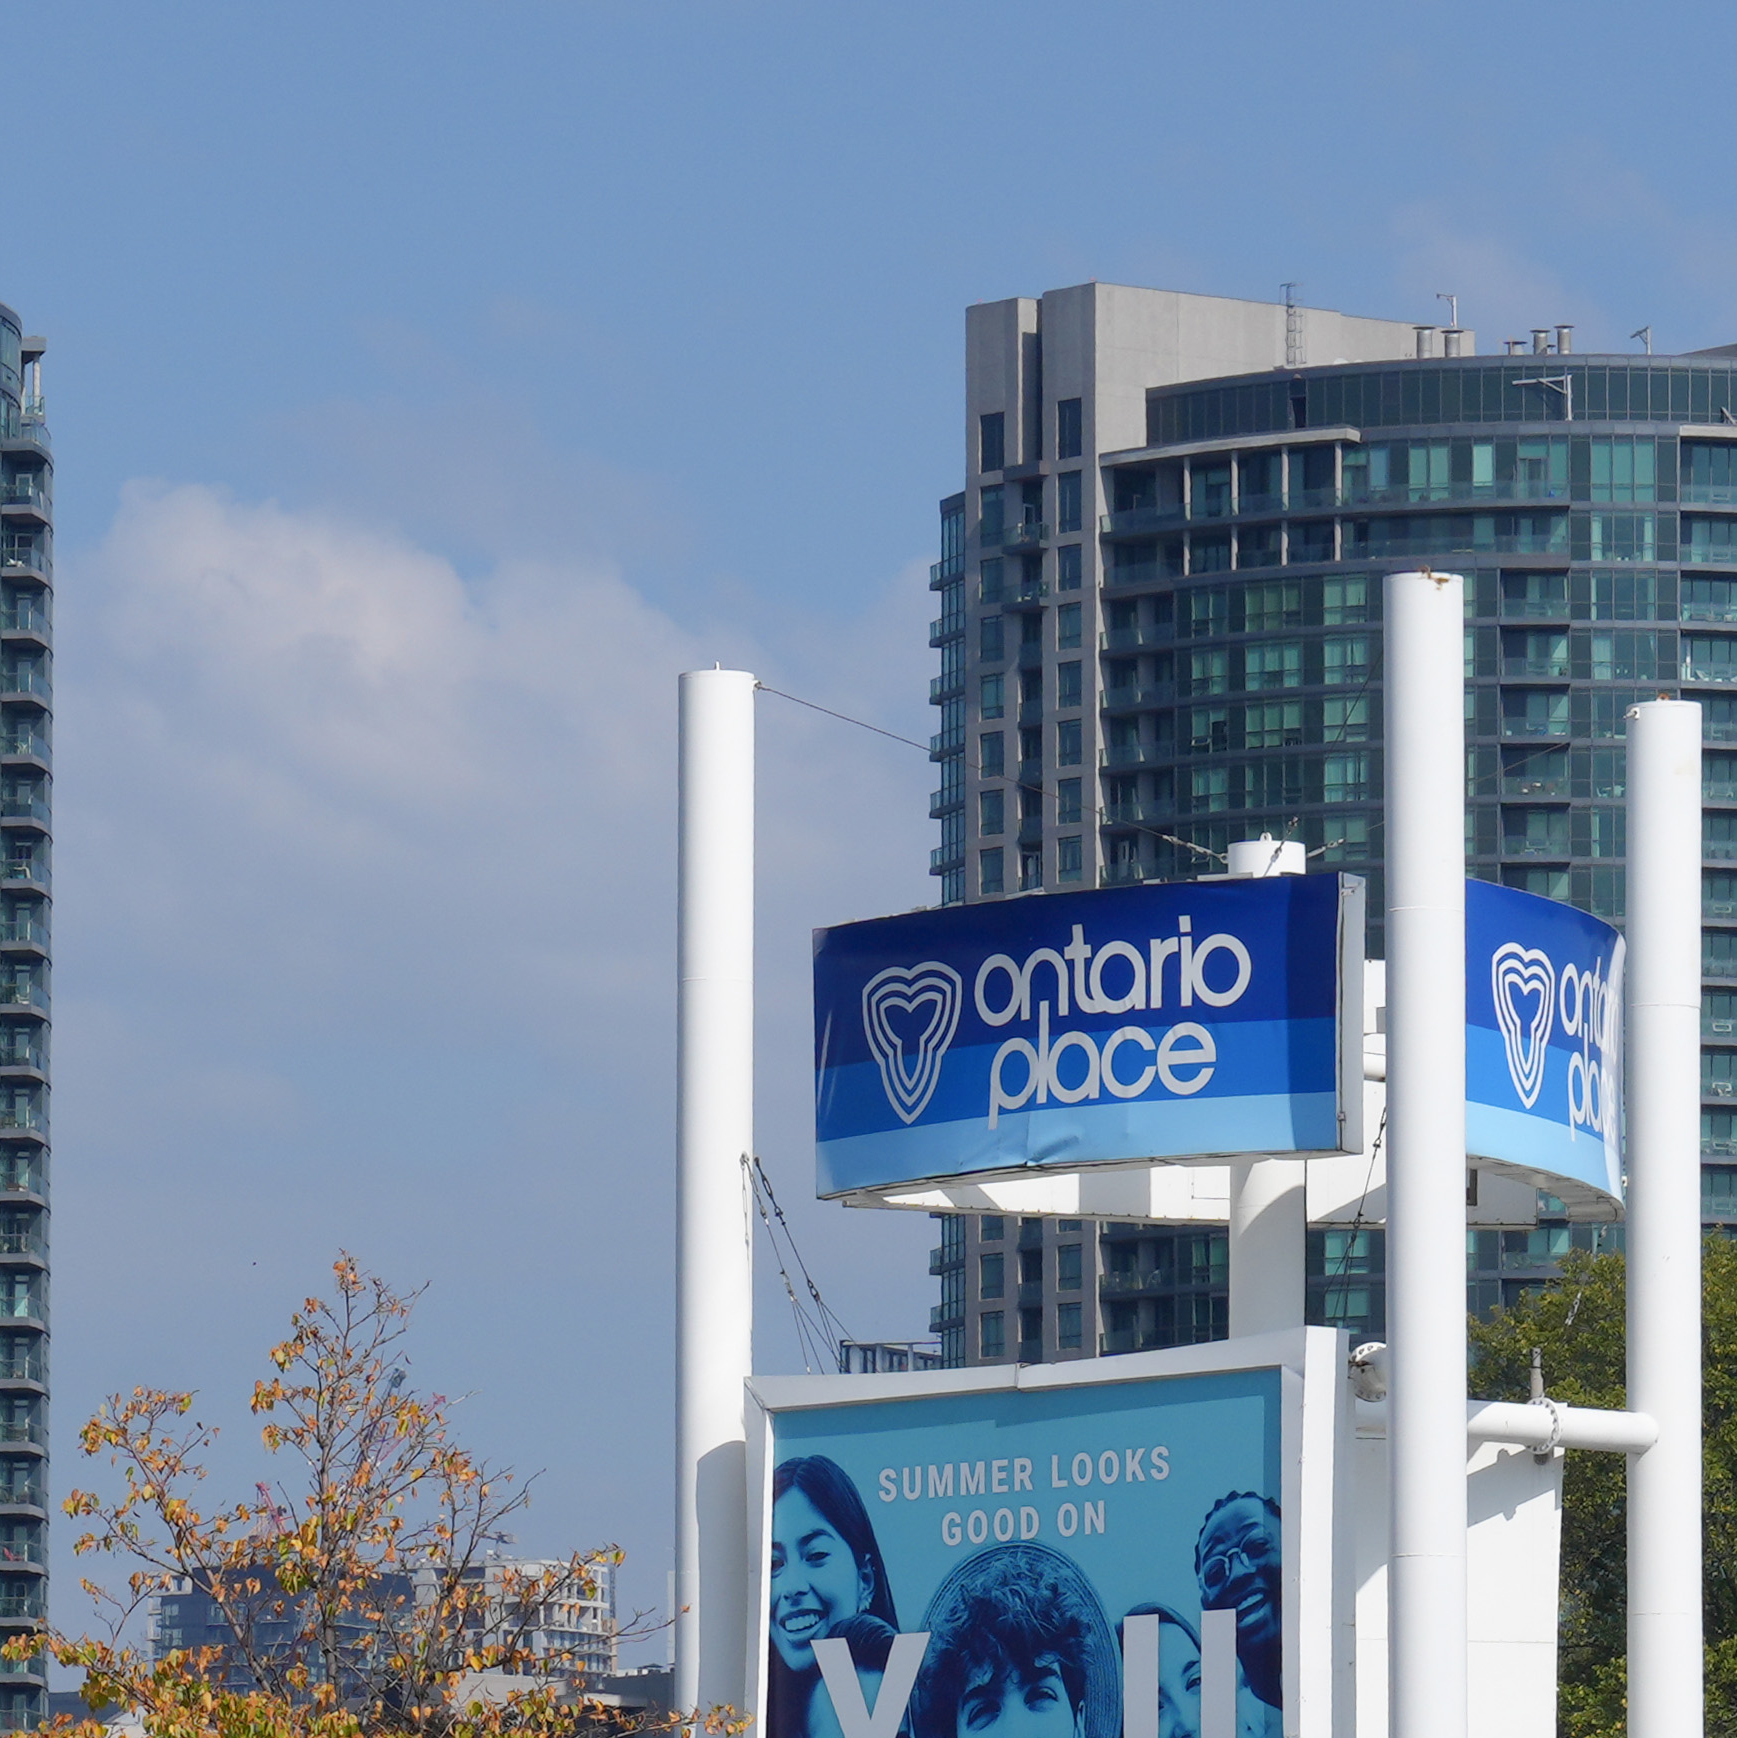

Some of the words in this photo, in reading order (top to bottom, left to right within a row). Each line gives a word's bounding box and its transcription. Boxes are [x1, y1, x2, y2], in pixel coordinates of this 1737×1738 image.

[975, 915, 1252, 1027] ontario
[1559, 956, 1619, 1064] onta
[989, 998, 1217, 1131] place
[1567, 1022, 1615, 1143] pla
[878, 1456, 1034, 1503] SUMMER
[1050, 1445, 1171, 1487] LOOKS
[942, 1504, 1041, 1547] GOOD
[1057, 1500, 1107, 1537] ON
